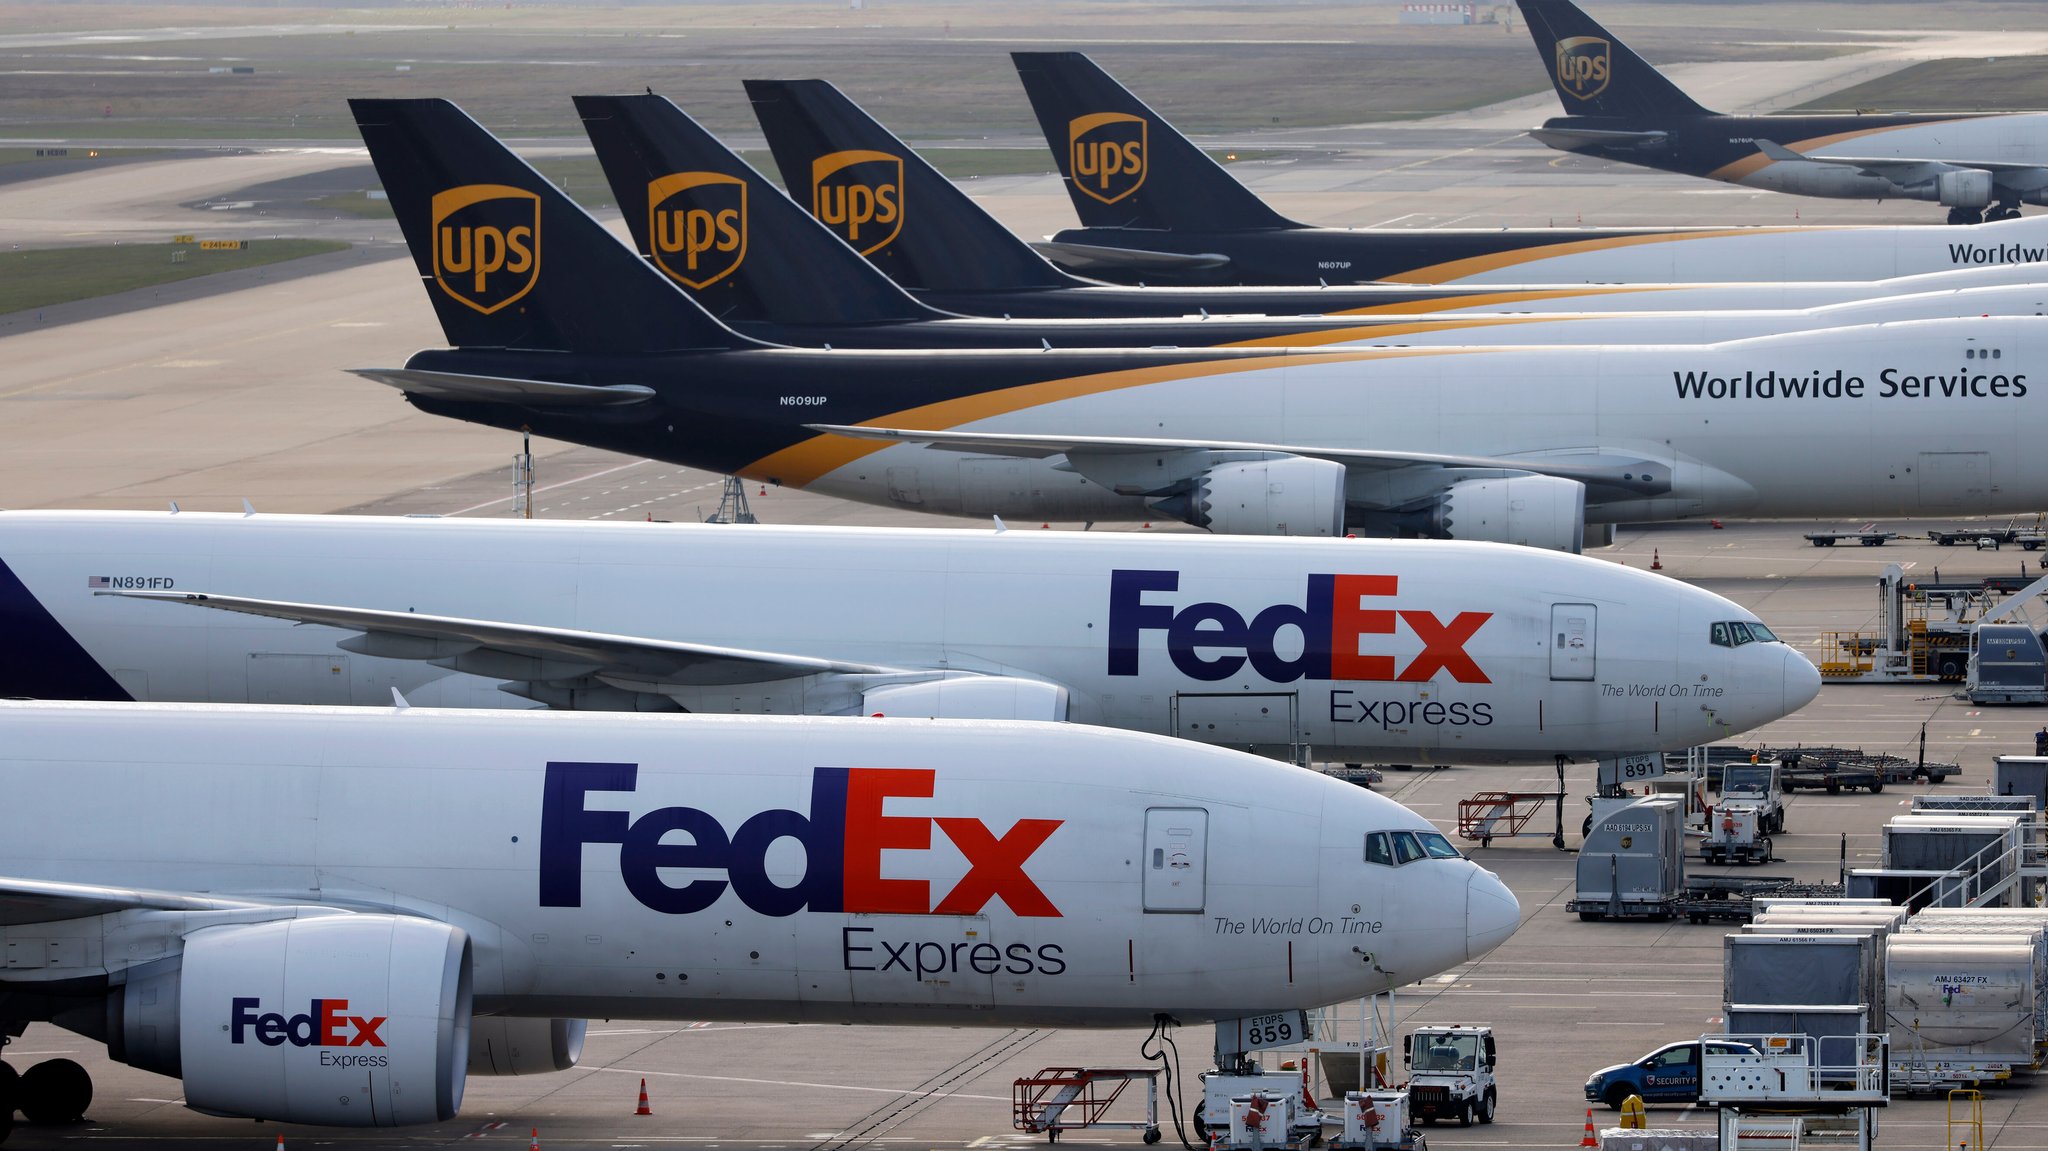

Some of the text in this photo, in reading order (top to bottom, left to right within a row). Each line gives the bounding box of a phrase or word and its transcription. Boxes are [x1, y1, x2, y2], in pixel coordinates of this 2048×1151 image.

[1560, 55, 1606, 90] ups
[1076, 141, 1142, 189] ups
[821, 183, 897, 241] ups
[657, 208, 740, 270] ups
[441, 225, 533, 293] ups
[1318, 261, 1352, 269] N607UP
[1673, 367, 2028, 399] Worldwide Services
[780, 396, 827, 406] N609UP
[112, 576, 174, 589] N891FD
[1107, 569, 1494, 684] FedEx
[1602, 684, 1724, 697] The World On Time
[1330, 690, 1494, 731] Express
[1625, 762, 1654, 778] 891
[1626, 755, 1649, 765] ETOPS
[539, 761, 1066, 918] FedEx
[1214, 917, 1383, 935] The World On Time
[843, 926, 1067, 982] Express
[1935, 975, 1952, 983] AMJ
[1977, 976, 1988, 984] FX
[231, 997, 388, 1047] FedEx
[1252, 1014, 1284, 1027] ETOPS
[1249, 1023, 1292, 1045] 859
[320, 1051, 388, 1070] Express
[1656, 1077, 1690, 1085] SECURITY
